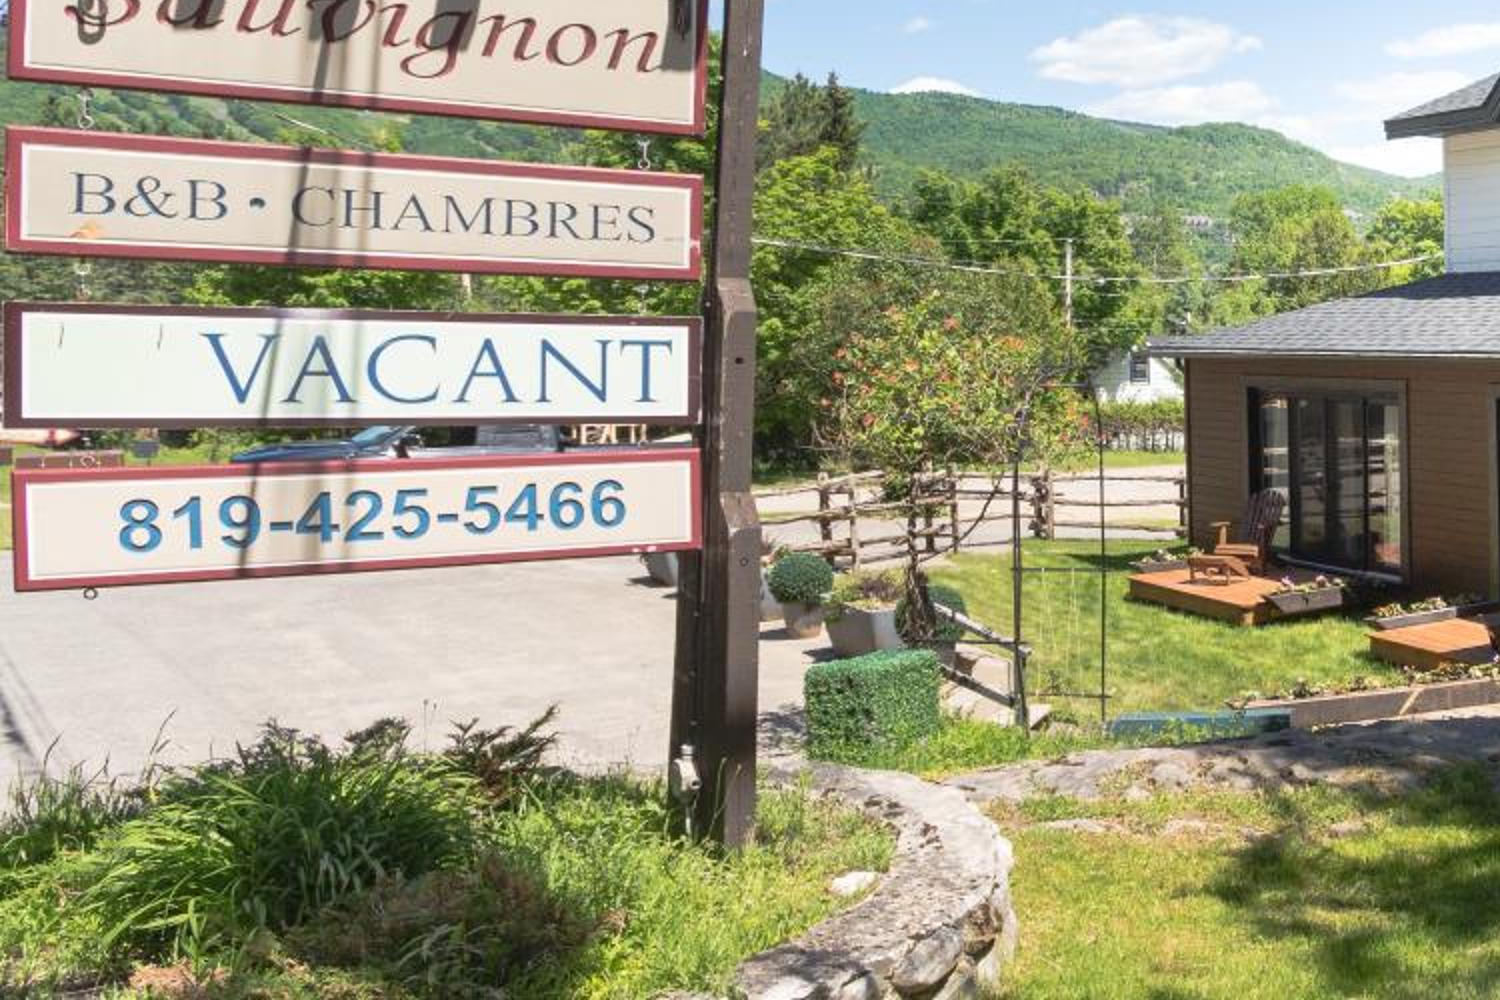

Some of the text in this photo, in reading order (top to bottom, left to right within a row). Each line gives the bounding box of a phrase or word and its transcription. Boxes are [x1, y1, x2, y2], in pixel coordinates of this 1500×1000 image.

[70, 171, 657, 245] B&B CHAMBRES
[200, 332, 674, 404] VACANT
[118, 479, 628, 554] 819-425-5466
